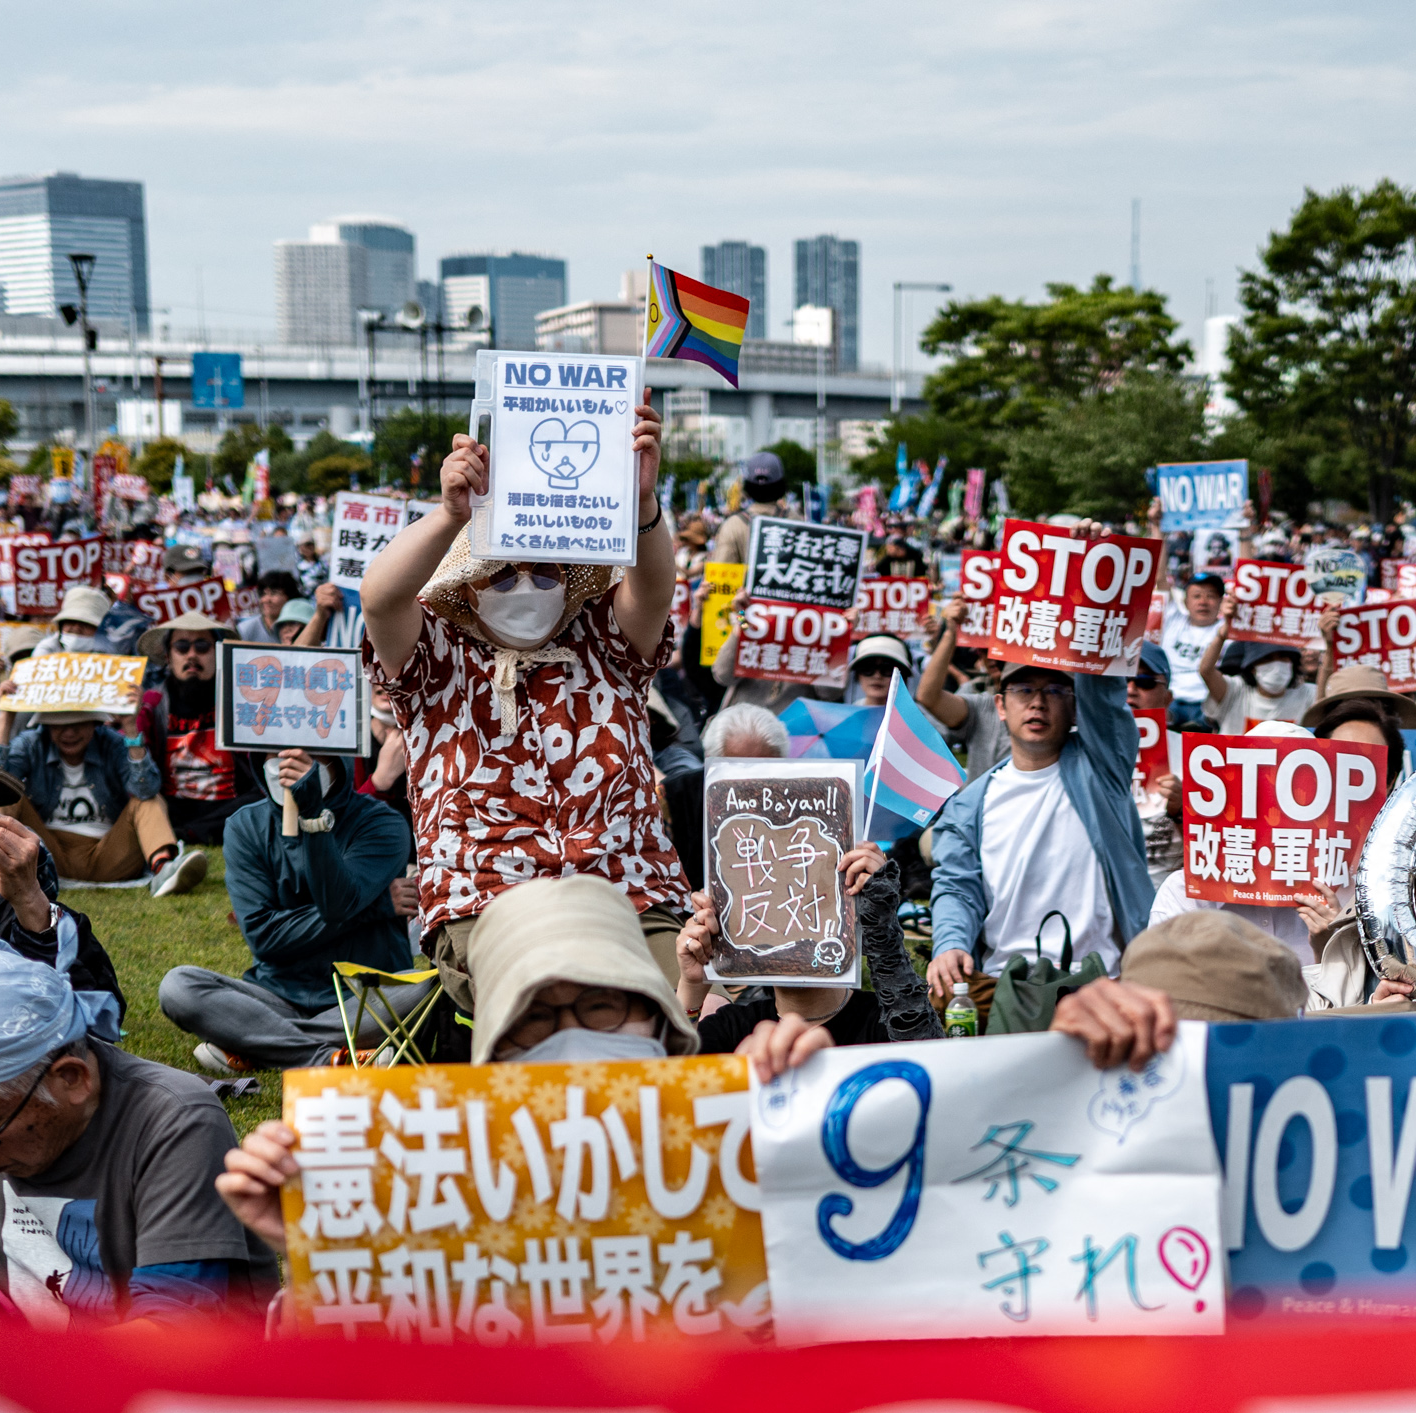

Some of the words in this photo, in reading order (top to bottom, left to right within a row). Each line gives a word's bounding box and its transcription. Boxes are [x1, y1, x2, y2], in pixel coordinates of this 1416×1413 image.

[505, 362, 551, 387] NO
[559, 363, 627, 389] WAR
[503, 396, 613, 416] 平和がいいもん
[507, 492, 619, 510] 漫画も描きたいし
[1159, 476, 1193, 512] NO
[1194, 472, 1244, 511] WAR
[343, 501, 402, 526] 高市
[514, 513, 613, 531] おいしいものも
[16, 540, 102, 581] STOP
[336, 557, 365, 579] 憲
[756, 554, 855, 595] 大反対!!
[1003, 530, 1153, 605] STOP
[1314, 558, 1339, 573] NO
[856, 581, 928, 609] STOP
[1235, 563, 1326, 607] STO
[1324, 575, 1357, 588] WAR
[138, 581, 223, 622] STOP
[743, 604, 848, 647] STOP
[995, 596, 1129, 658] 改憲・軍拡
[15, 654, 141, 685] 憲法いかして
[738, 641, 831, 676] 改憲・軍拡
[236, 663, 353, 691] 国会議員は
[6, 682, 121, 707] 平和な世界を
[236, 703, 346, 730] 憲法守れ!
[1188, 744, 1377, 823] STOP
[726, 787, 757, 811] Ano
[732, 824, 828, 888] 戦争
[1188, 822, 1352, 888] 改憲・軍拡
[1233, 889, 1254, 900] Peace
[1255, 891, 1261, 900] &
[1263, 892, 1293, 901] Human
[293, 1085, 763, 1239] 憲法いかして
[307, 1231, 722, 1347] 平和な世界を
[1282, 1296, 1335, 1315] Peace
